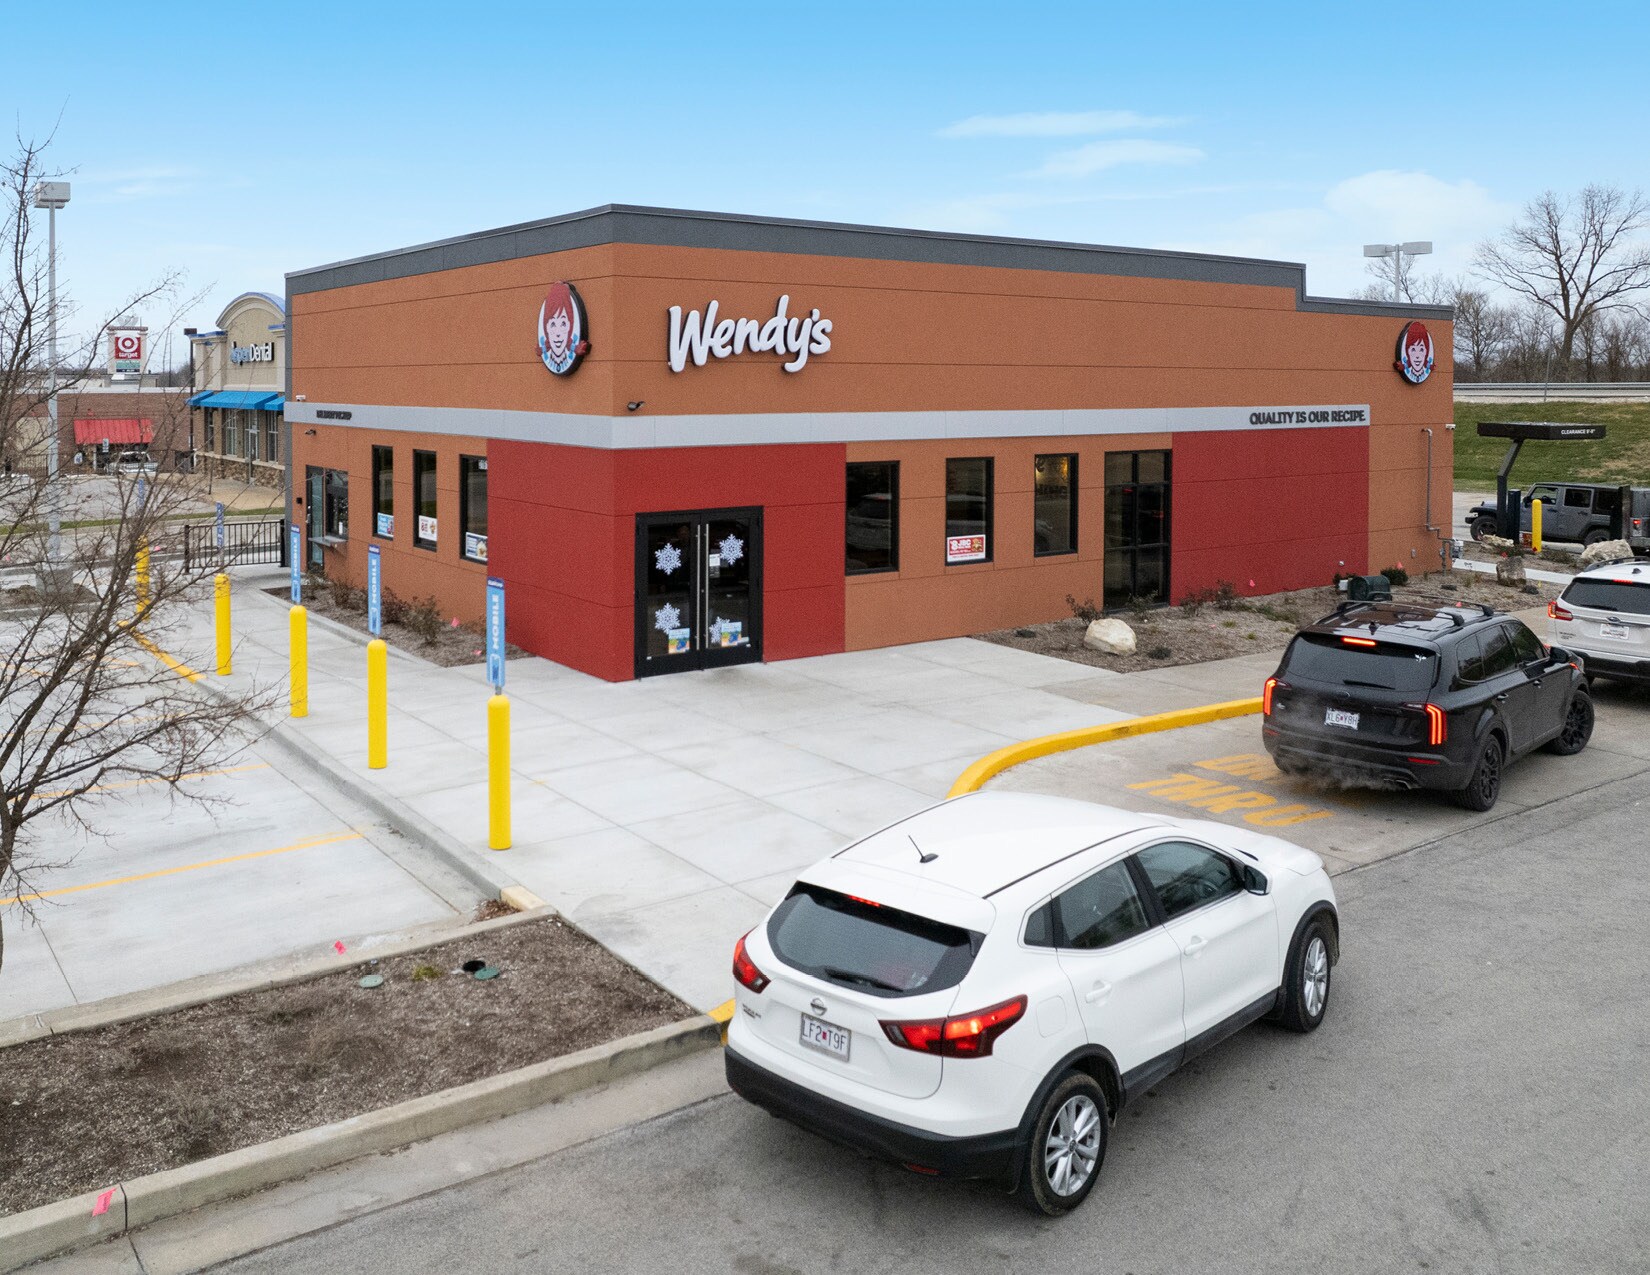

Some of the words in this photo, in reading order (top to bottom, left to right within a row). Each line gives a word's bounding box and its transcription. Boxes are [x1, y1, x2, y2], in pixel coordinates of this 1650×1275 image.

[668, 294, 833, 373] Wendy's
[1249, 412, 1294, 425] QUALITY
[1295, 411, 1307, 424] IS
[1308, 410, 1329, 423] OUR
[1331, 409, 1366, 422] RECIPE
[492, 594, 500, 650] MOBILE
[1125, 772, 1336, 827] THRU
[802, 1019, 822, 1042] LF2
[827, 1029, 846, 1052] T9F
